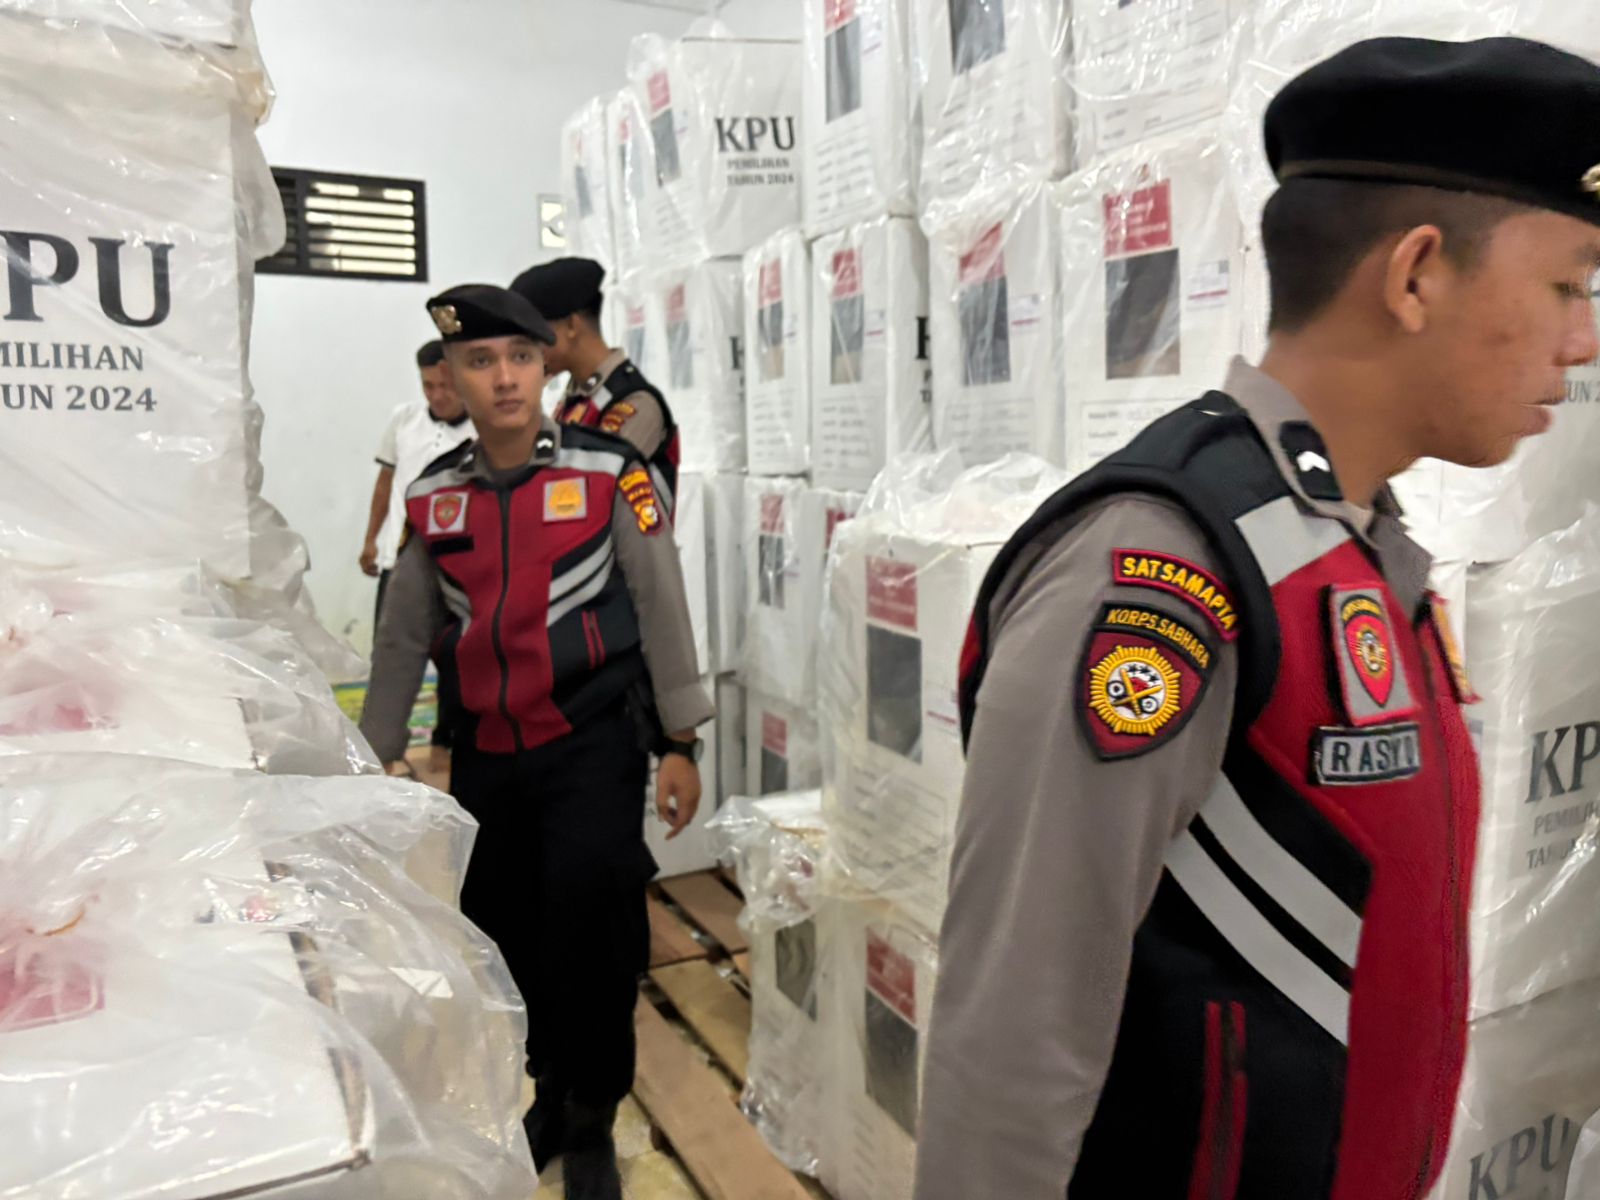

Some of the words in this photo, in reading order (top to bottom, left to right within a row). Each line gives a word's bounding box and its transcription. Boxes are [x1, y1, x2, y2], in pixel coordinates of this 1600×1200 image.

[714, 116, 796, 152] KPU
[66, 385, 157, 411] 2024
[1122, 557, 1161, 579] SAT
[1160, 563, 1238, 631] SAMAPTA
[1106, 608, 1158, 631] KORPS
[1156, 618, 1210, 669] SABHARA
[1468, 1113, 1571, 1200] KPU
